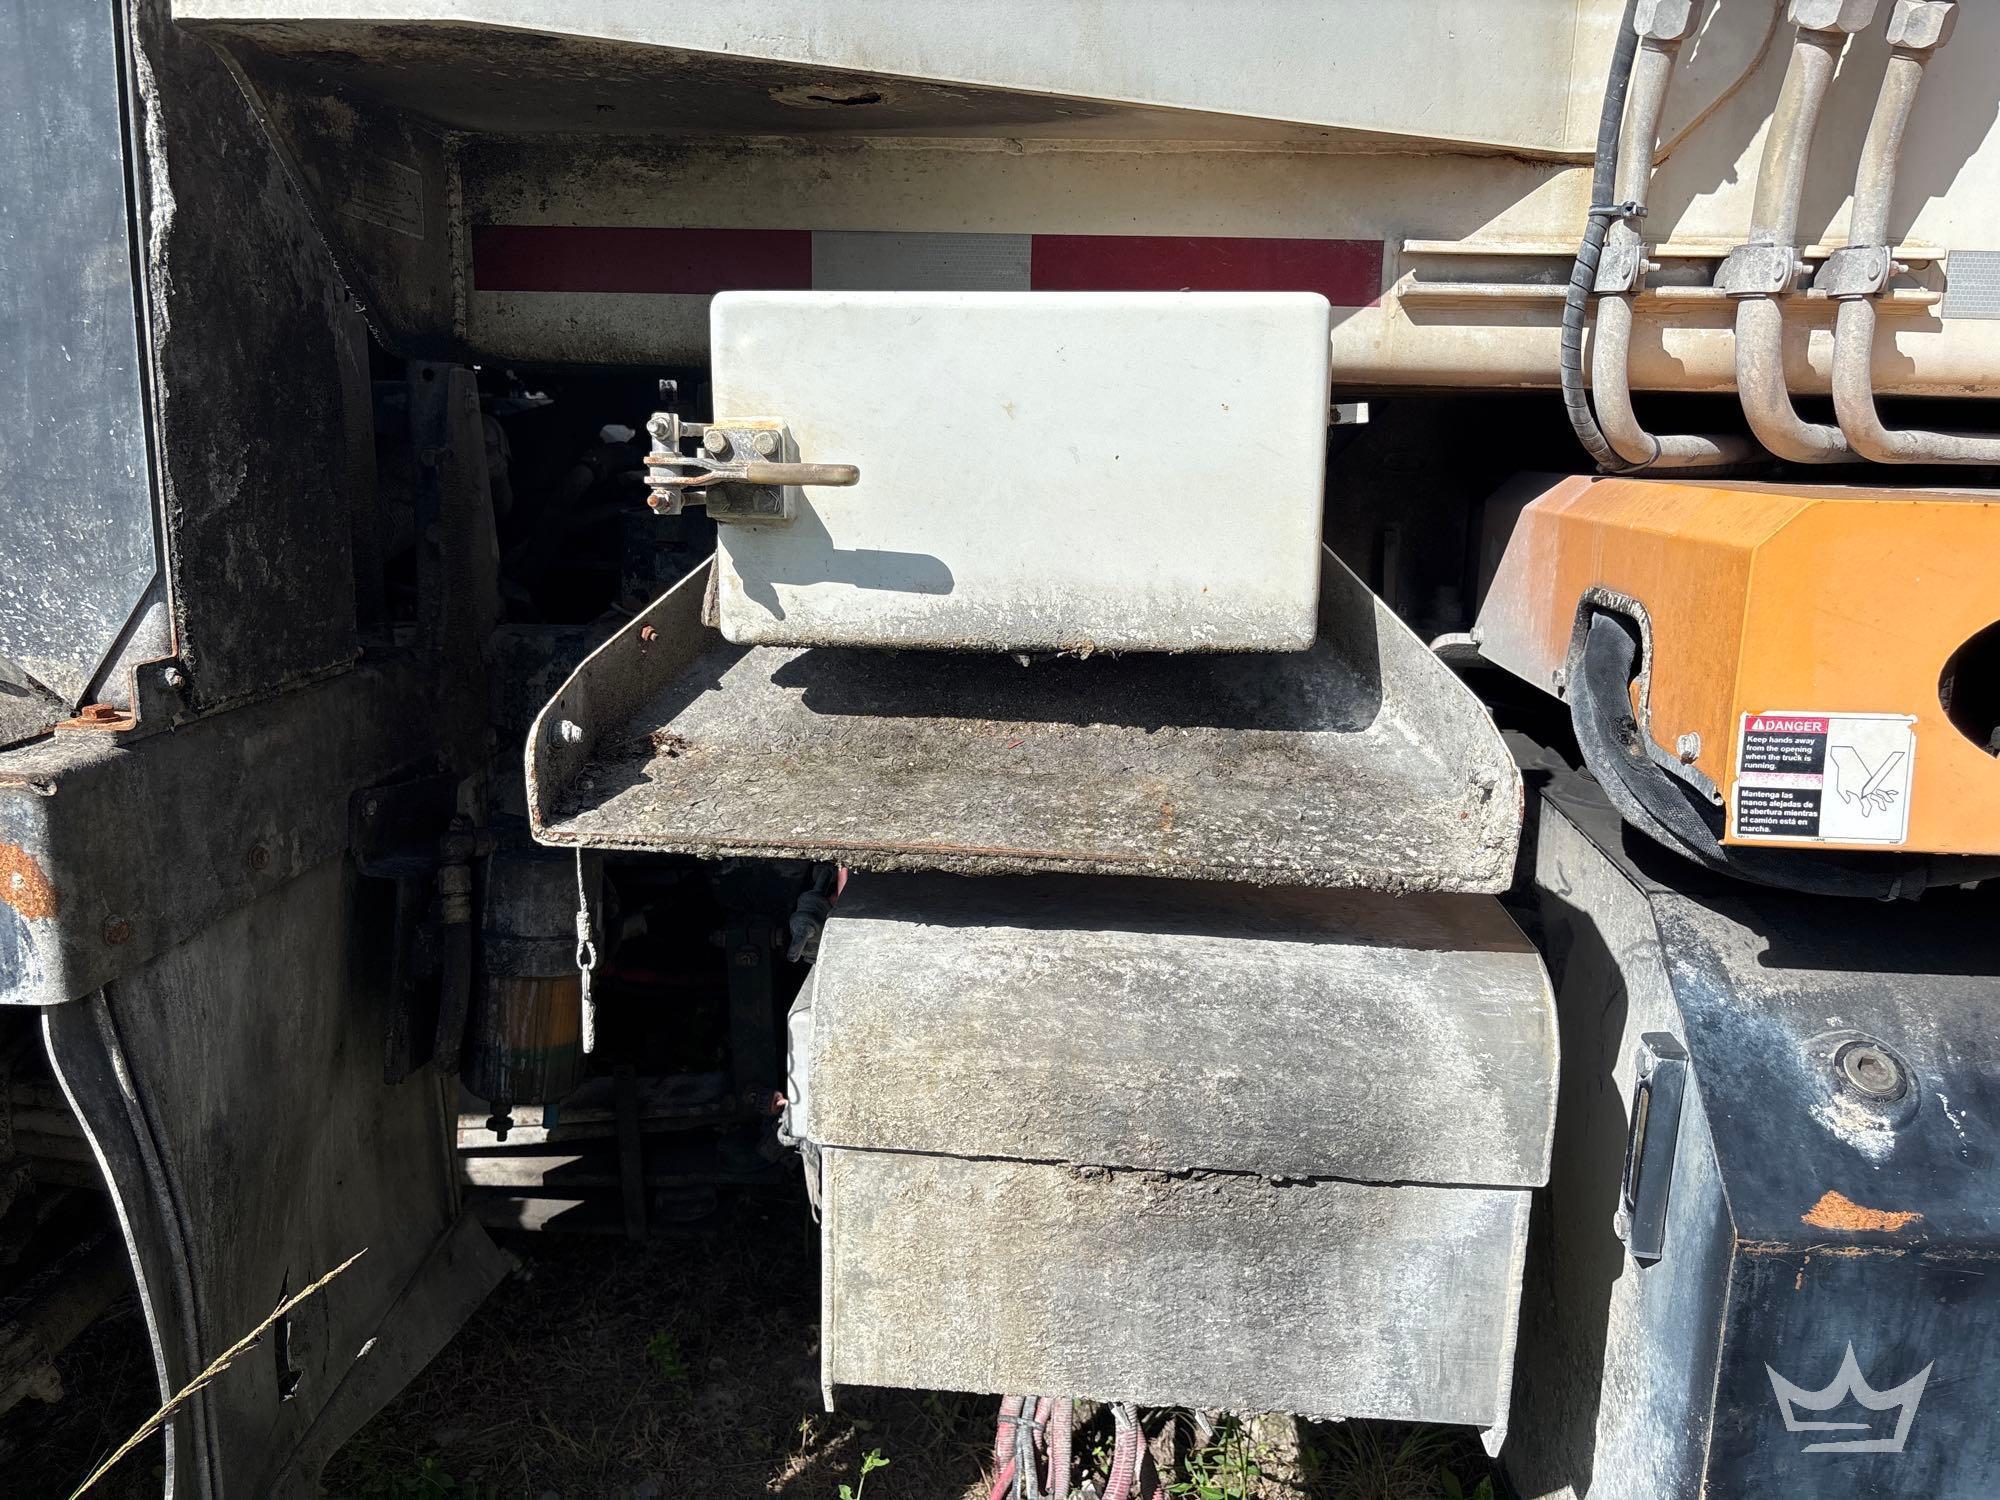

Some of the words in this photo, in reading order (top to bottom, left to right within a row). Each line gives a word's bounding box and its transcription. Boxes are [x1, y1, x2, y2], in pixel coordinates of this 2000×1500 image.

[1765, 720, 1822, 732] DANGER
[1747, 736, 1767, 744] Keep
[1780, 746, 1812, 754] opening
[1744, 762, 1776, 770] running.
[1741, 790, 1780, 799] Mantenga
[1781, 791, 1793, 799] las
[1769, 800, 1802, 808] alejadas
[1783, 809, 1818, 817] mientras
